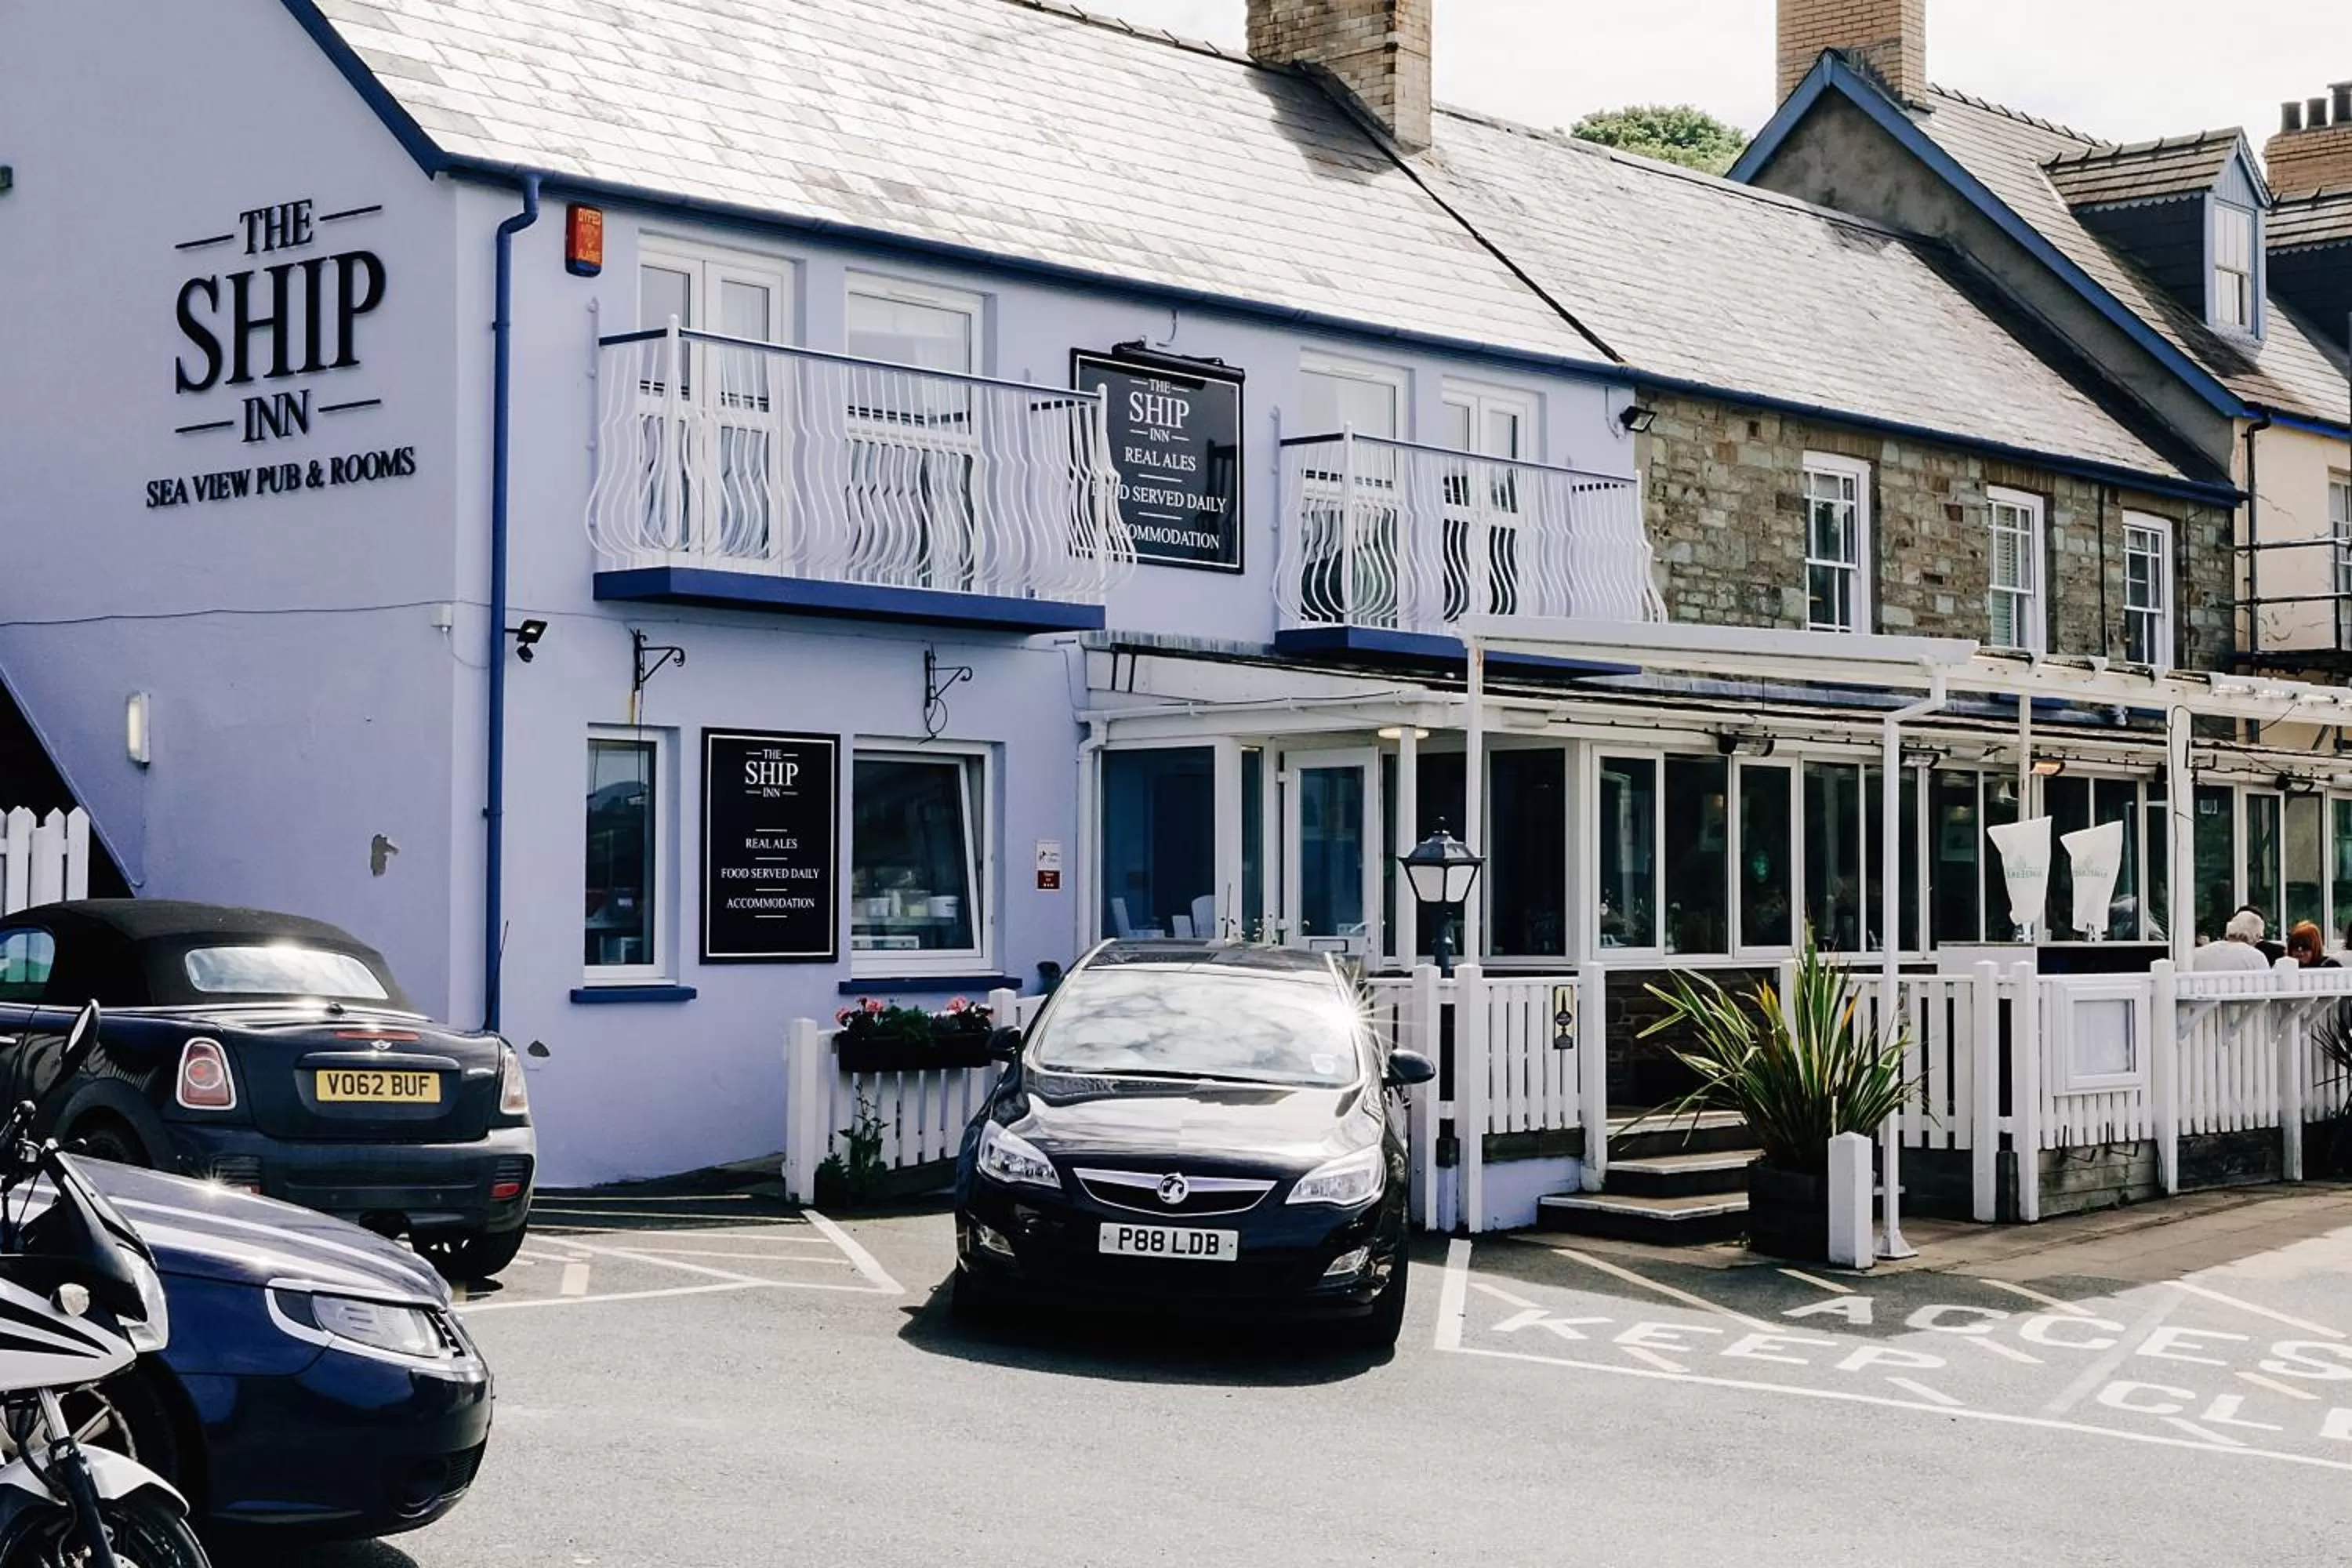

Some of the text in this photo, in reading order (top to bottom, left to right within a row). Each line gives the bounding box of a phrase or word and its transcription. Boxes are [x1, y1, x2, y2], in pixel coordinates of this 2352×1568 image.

[240, 199, 313, 256] THE
[175, 250, 387, 394] SHIP
[1150, 379, 1171, 393] THE
[241, 390, 311, 443] INN
[1129, 391, 1190, 429] SHIP
[1149, 428, 1171, 442] INN
[1124, 447, 1196, 472] REAL ALES
[146, 446, 416, 508] SEA VIEW PUB & ROOMS
[1132, 485, 1185, 508] SERVED
[1187, 493, 1227, 514] DAILY
[1109, 520, 1220, 549] OMMODATION
[762, 749, 782, 760] THE
[745, 760, 799, 786] SHIP
[762, 787, 781, 798] INN
[746, 838, 797, 850] REAL ALES
[720, 868, 820, 880] FOOD SERVED DAILY
[726, 897, 815, 909] ACCOMMODATION
[390, 1073, 430, 1097] BUF
[1117, 1228, 1220, 1255] P88 LDB
[1492, 1308, 1947, 1372] KEEP
